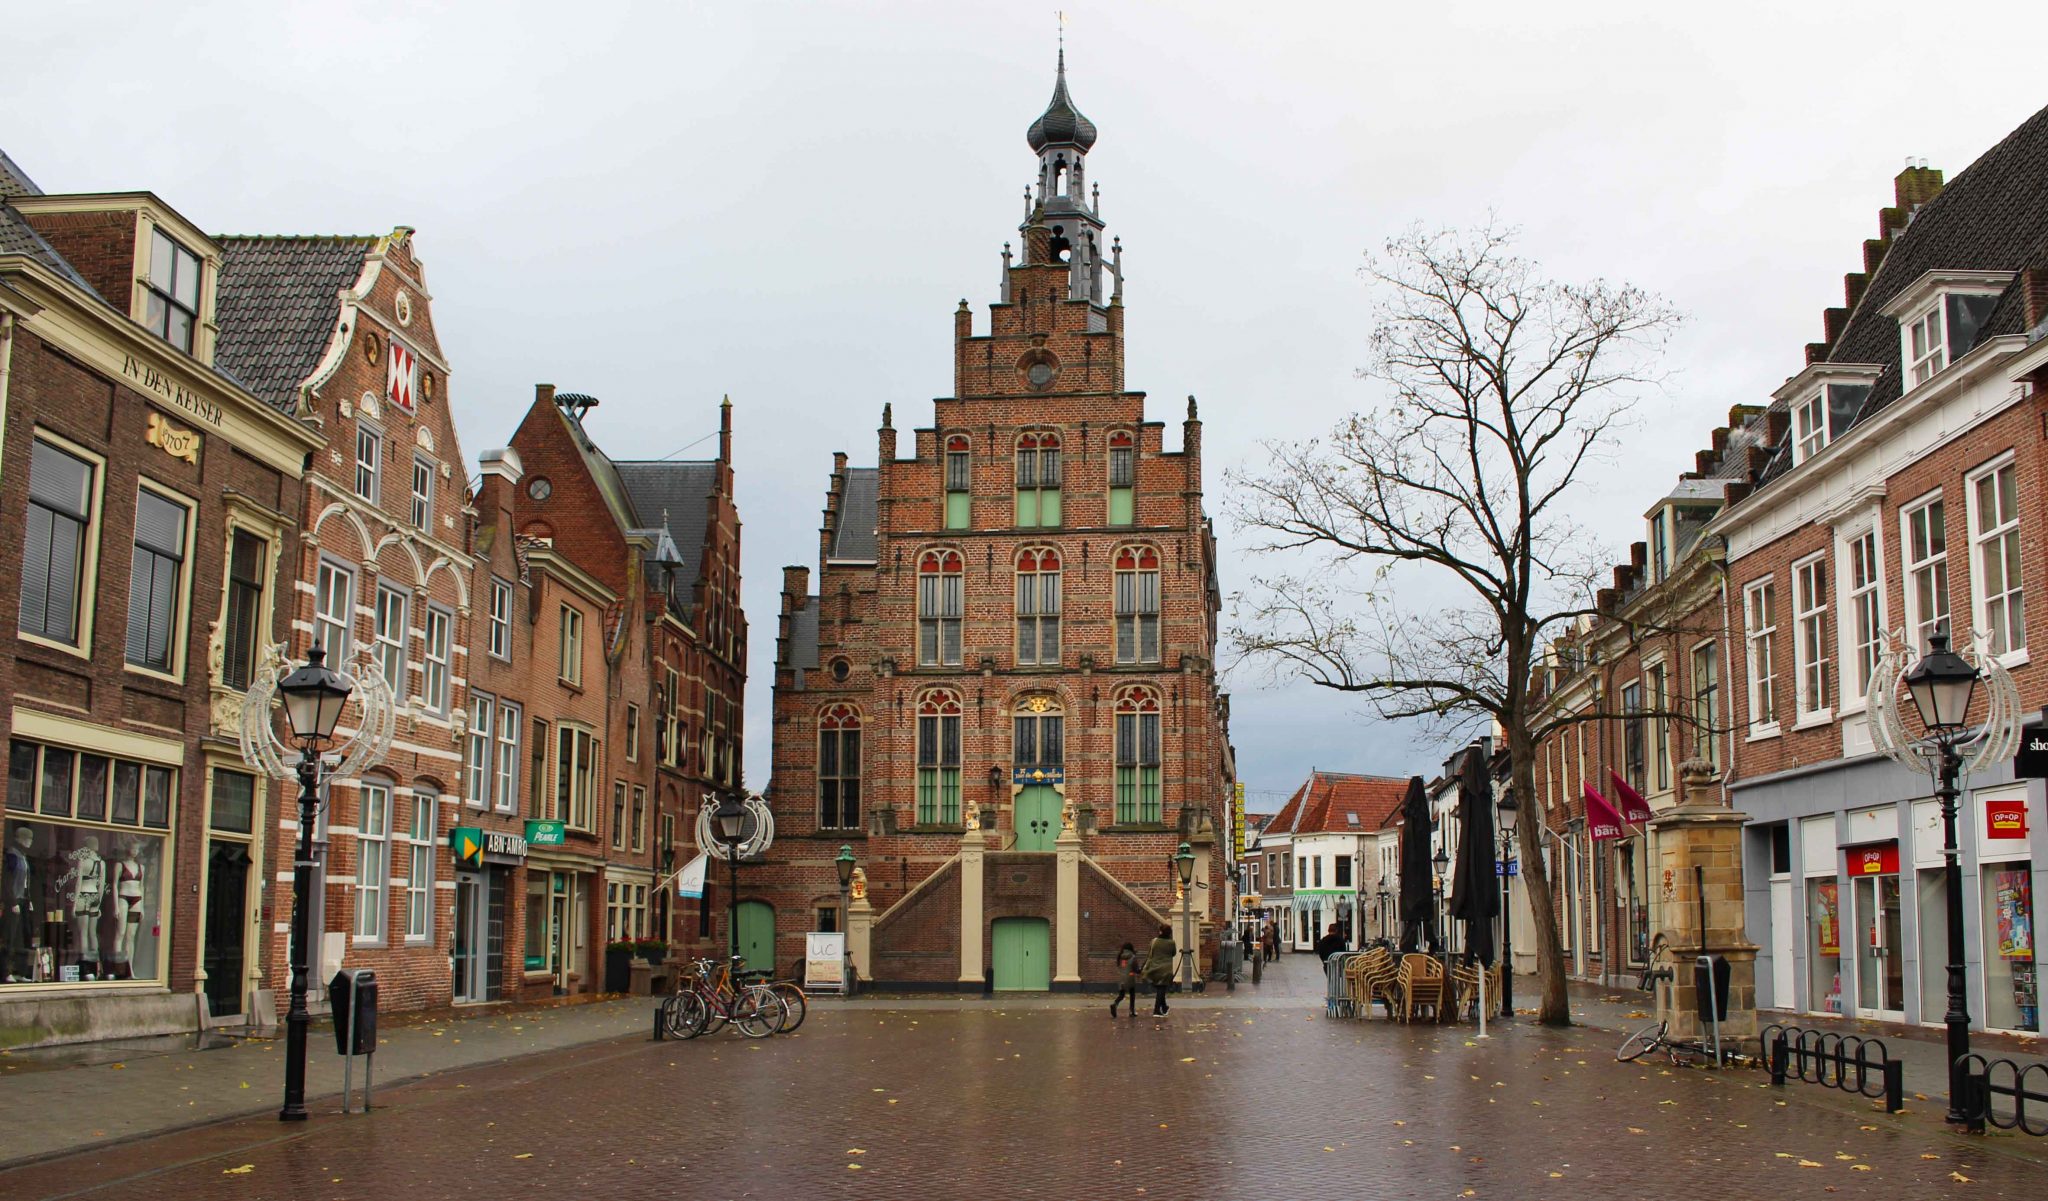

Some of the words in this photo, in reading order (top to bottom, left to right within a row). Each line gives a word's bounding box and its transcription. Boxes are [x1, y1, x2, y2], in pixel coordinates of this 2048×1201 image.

[124, 355, 139, 378] IN
[145, 368, 172, 397] DEN
[175, 387, 222, 427] KEYSER
[1594, 826, 1620, 837] bart
